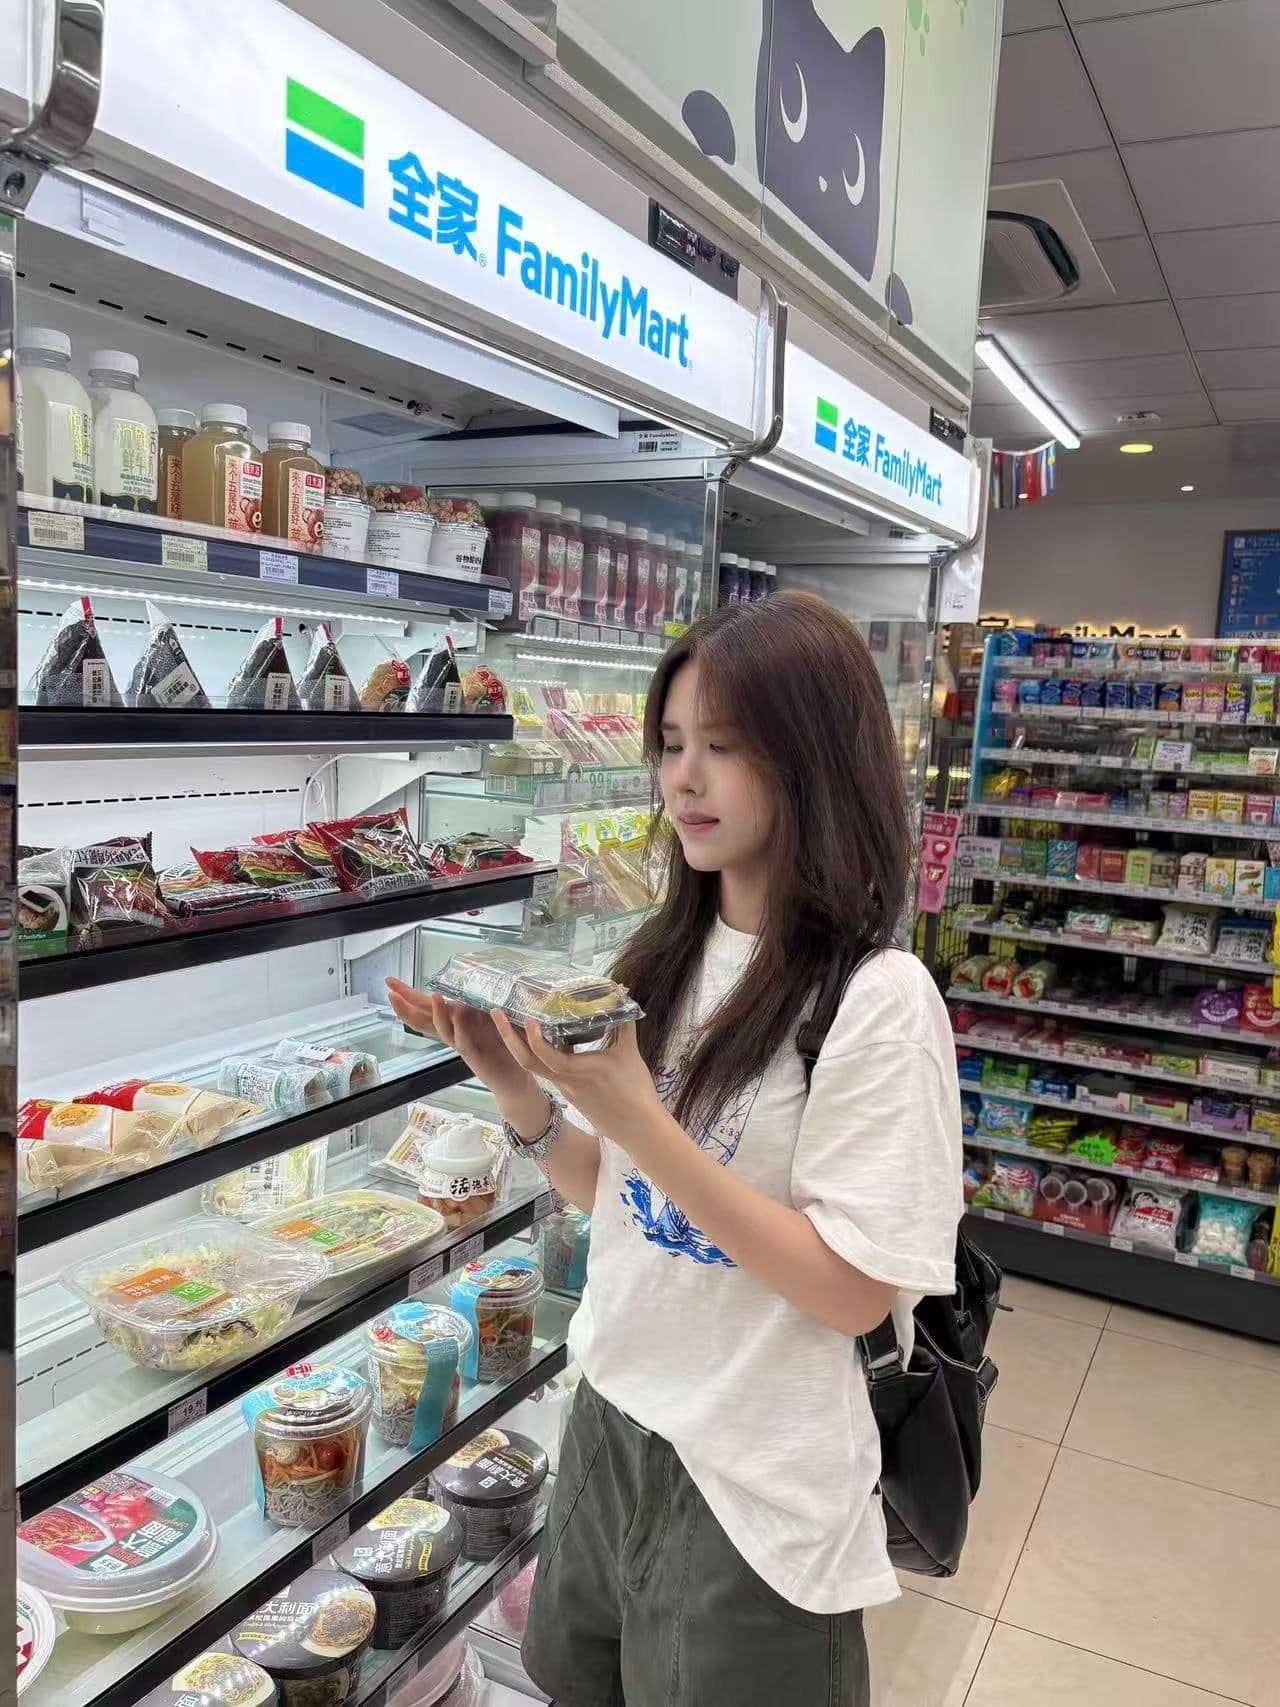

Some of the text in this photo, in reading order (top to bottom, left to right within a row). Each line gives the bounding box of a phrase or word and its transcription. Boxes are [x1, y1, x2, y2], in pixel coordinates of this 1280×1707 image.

[388, 151, 689, 368] 全家 FamilyMart
[842, 417, 943, 506] 全家 FamilyMart
[451, 1177, 470, 1195] 活
